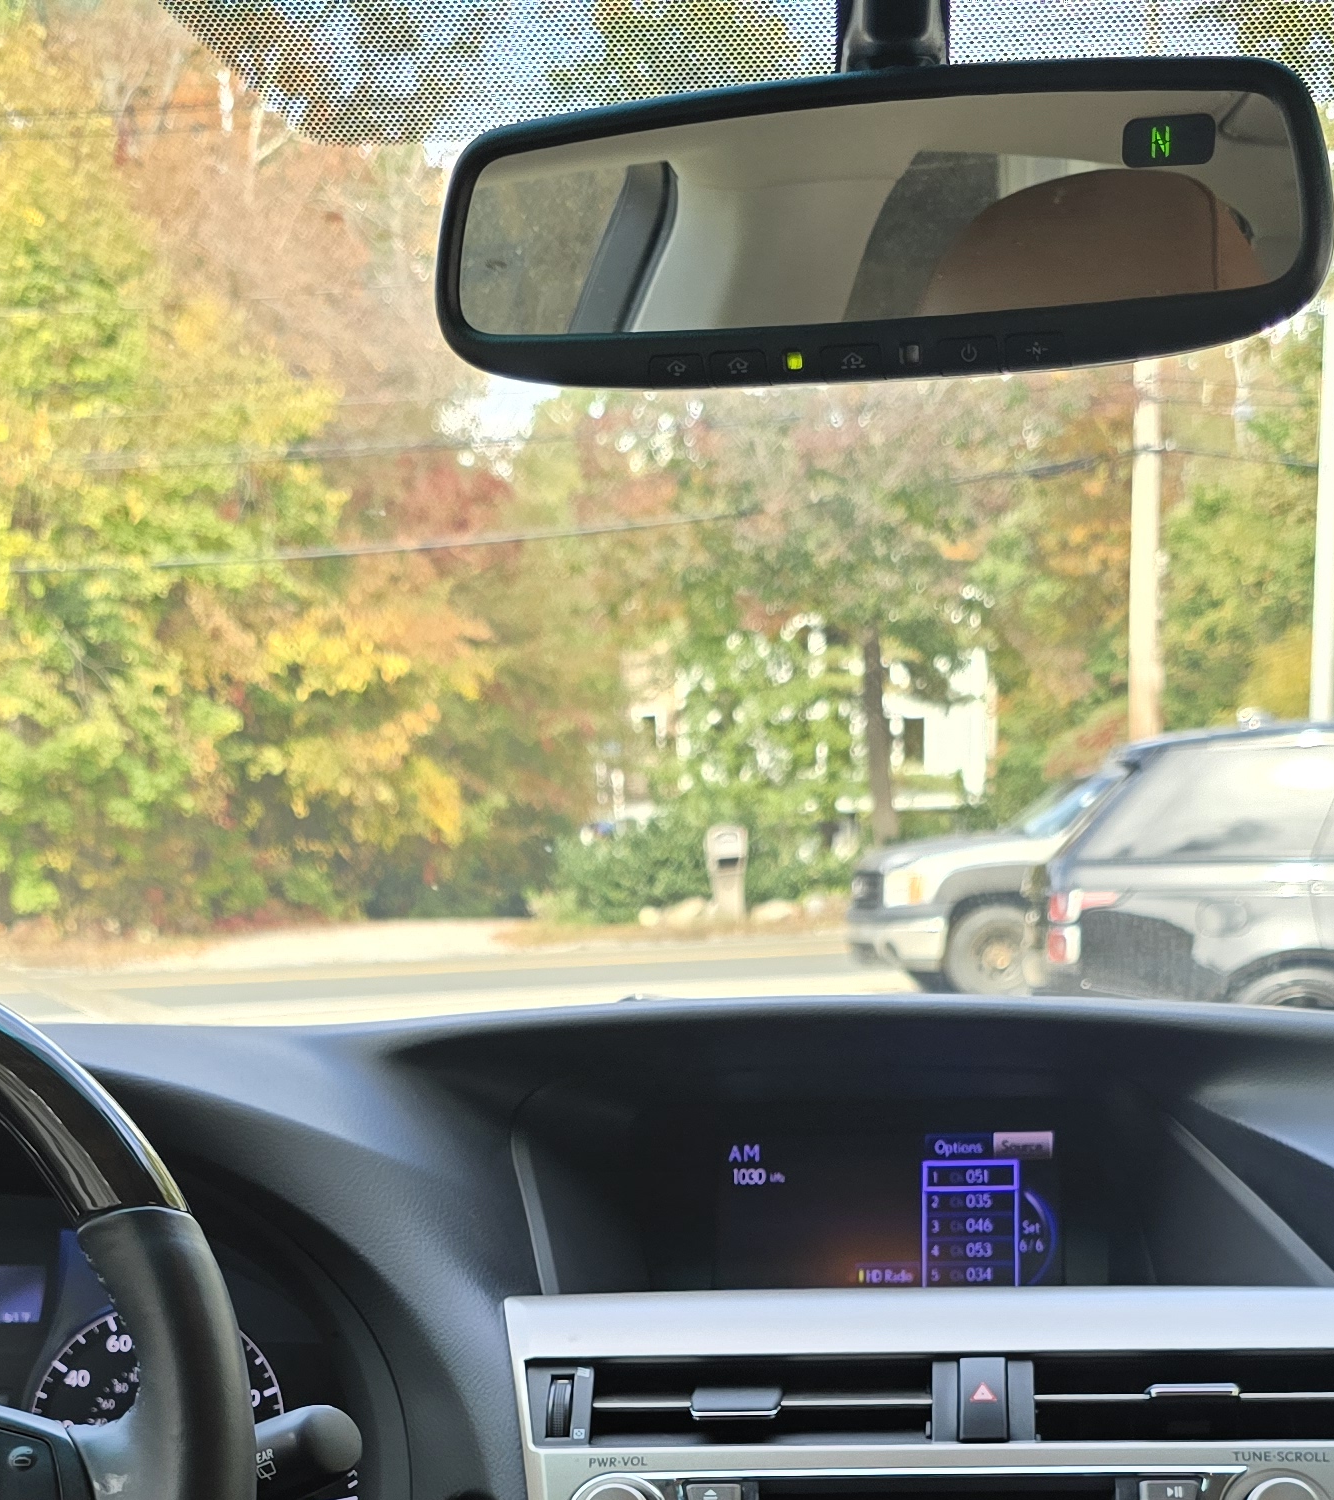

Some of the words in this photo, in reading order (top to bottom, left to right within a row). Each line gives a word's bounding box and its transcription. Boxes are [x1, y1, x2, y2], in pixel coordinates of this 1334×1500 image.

[1149, 124, 1172, 160] N
[728, 1144, 761, 1163] AM
[934, 1139, 984, 1157] Options
[931, 1171, 939, 1184] 1
[965, 1169, 990, 1184] 051
[931, 1195, 940, 1208] 2
[965, 1193, 994, 1208] 035
[931, 1220, 940, 1233] 3
[965, 1218, 994, 1233] 046
[1022, 1219, 1042, 1235] Set
[931, 1245, 940, 1258] 4
[965, 1243, 994, 1258] 053
[931, 1269, 940, 1282] 5
[965, 1267, 994, 1282] 034
[105, 1334, 133, 1353] 60
[63, 1369, 91, 1388] 40
[255, 1448, 275, 1464] EAR
